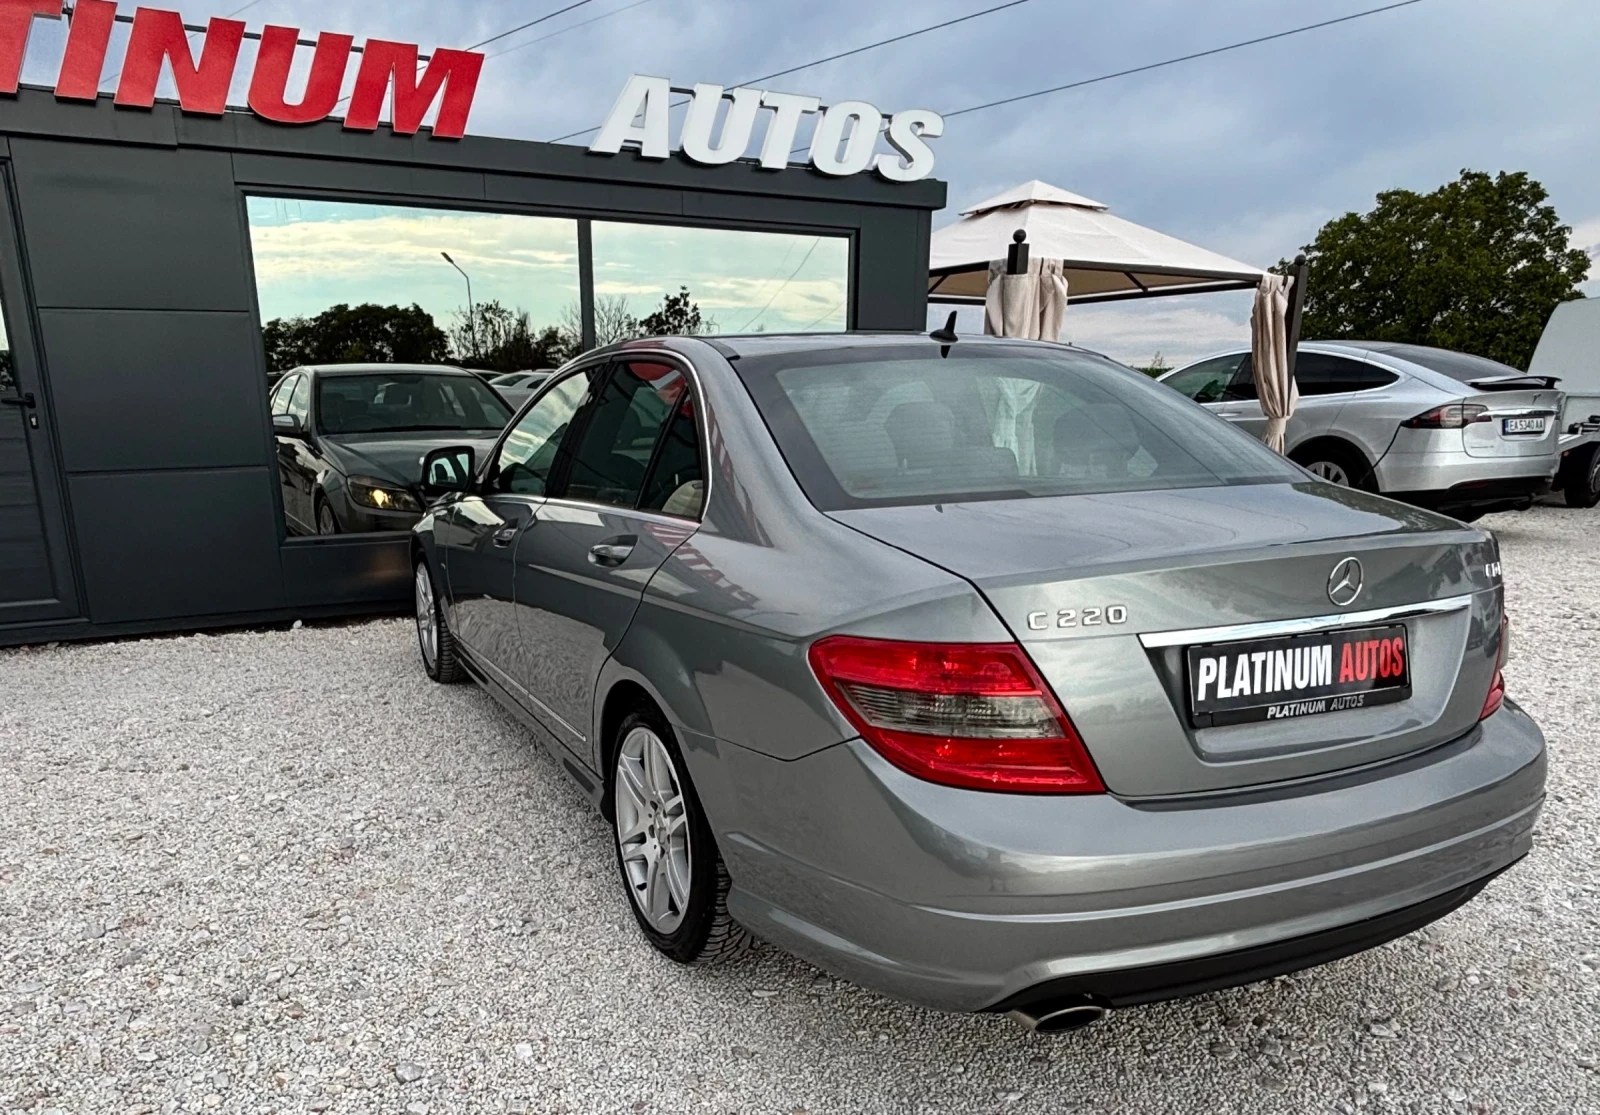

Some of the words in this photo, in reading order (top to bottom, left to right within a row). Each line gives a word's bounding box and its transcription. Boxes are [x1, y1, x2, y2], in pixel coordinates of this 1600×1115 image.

[589, 73, 944, 183] AUTOS
[1027, 611, 1048, 631] C
[1057, 604, 1128, 629] 220
[1197, 644, 1332, 701] PLATINUM
[1338, 637, 1404, 684] AUTOS
[1266, 700, 1326, 720] PLATINUM
[1329, 695, 1365, 711] AUTOS
